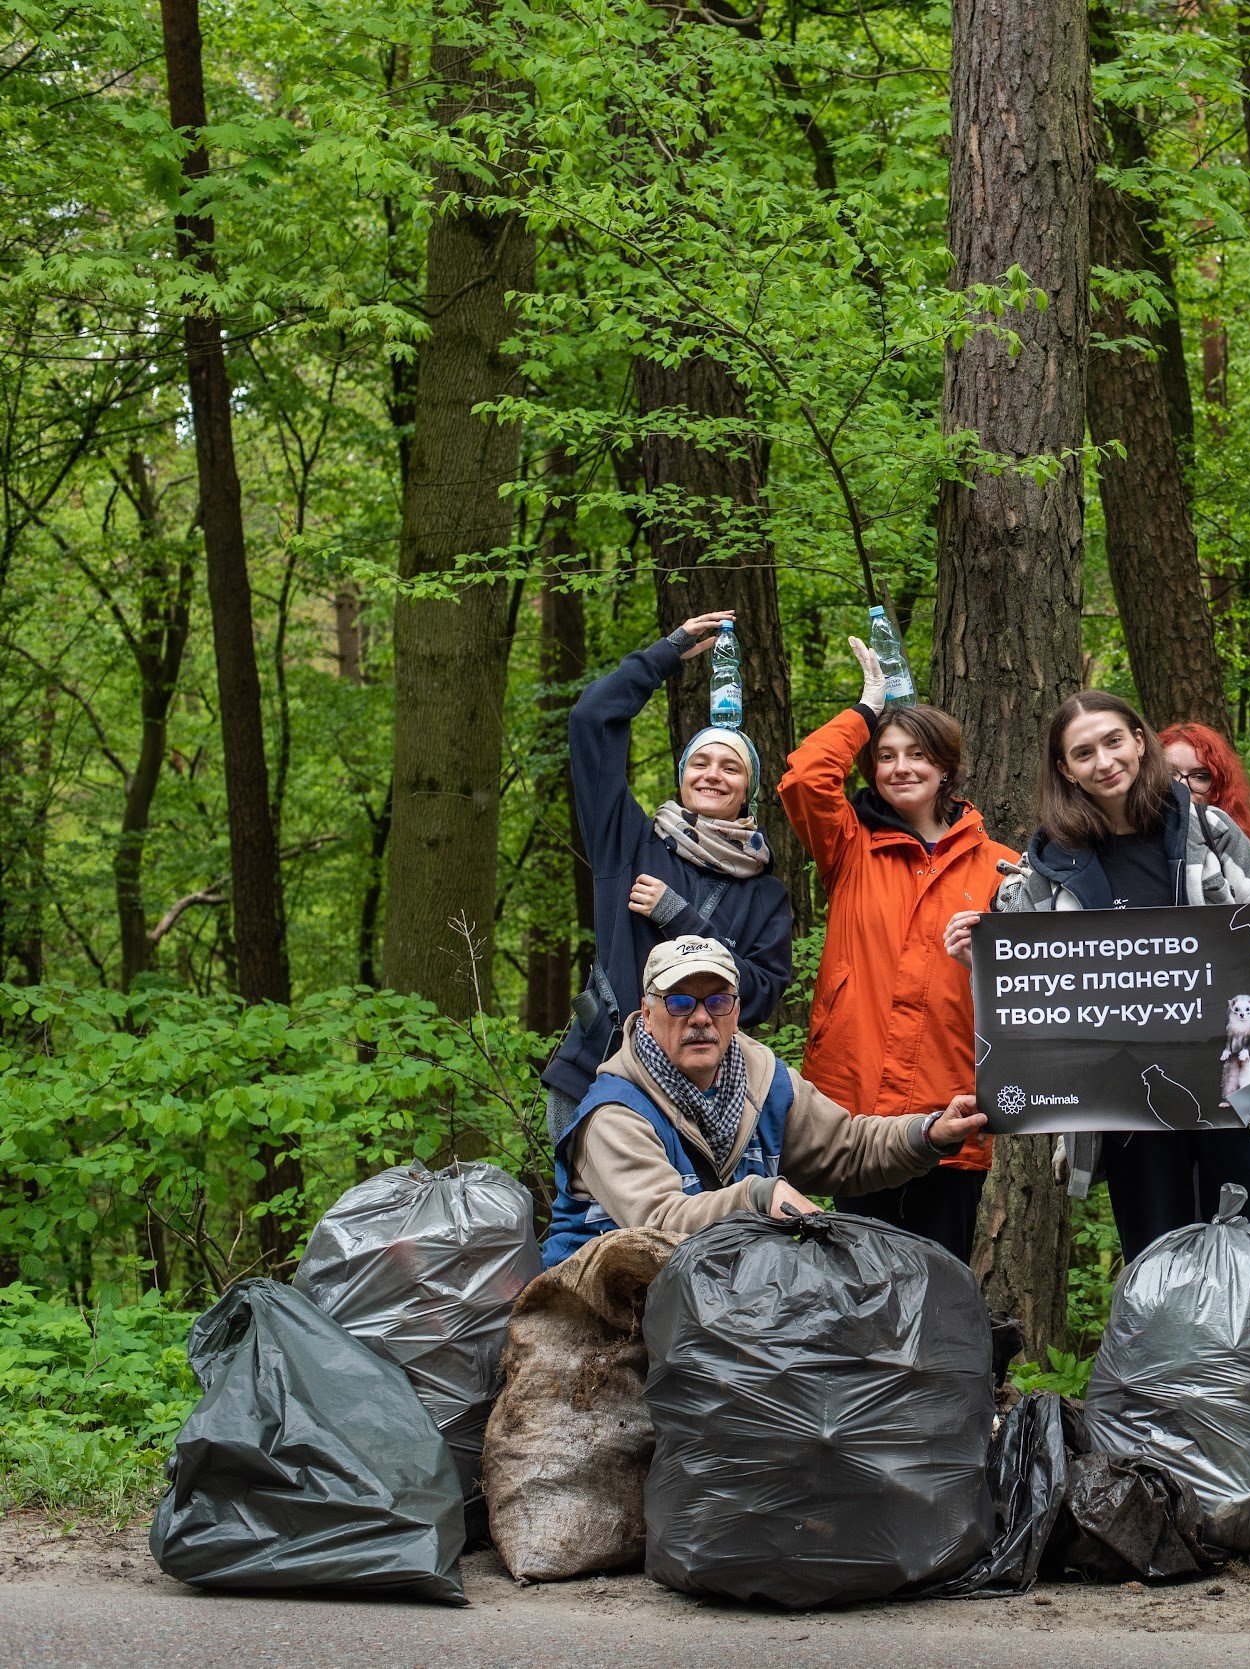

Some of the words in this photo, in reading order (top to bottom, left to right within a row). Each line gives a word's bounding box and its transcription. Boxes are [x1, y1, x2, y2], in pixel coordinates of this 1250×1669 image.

[676, 943, 709, 954] Texas
[995, 936, 1199, 961] Волонтерство
[996, 973, 1076, 998] рятує
[1082, 969, 1200, 992] планету
[1205, 962, 1212, 986] і
[996, 1006, 1071, 1025] твою
[1077, 998, 1203, 1028] ку-ку-ху!
[1030, 1094, 1080, 1106] UAnimals
